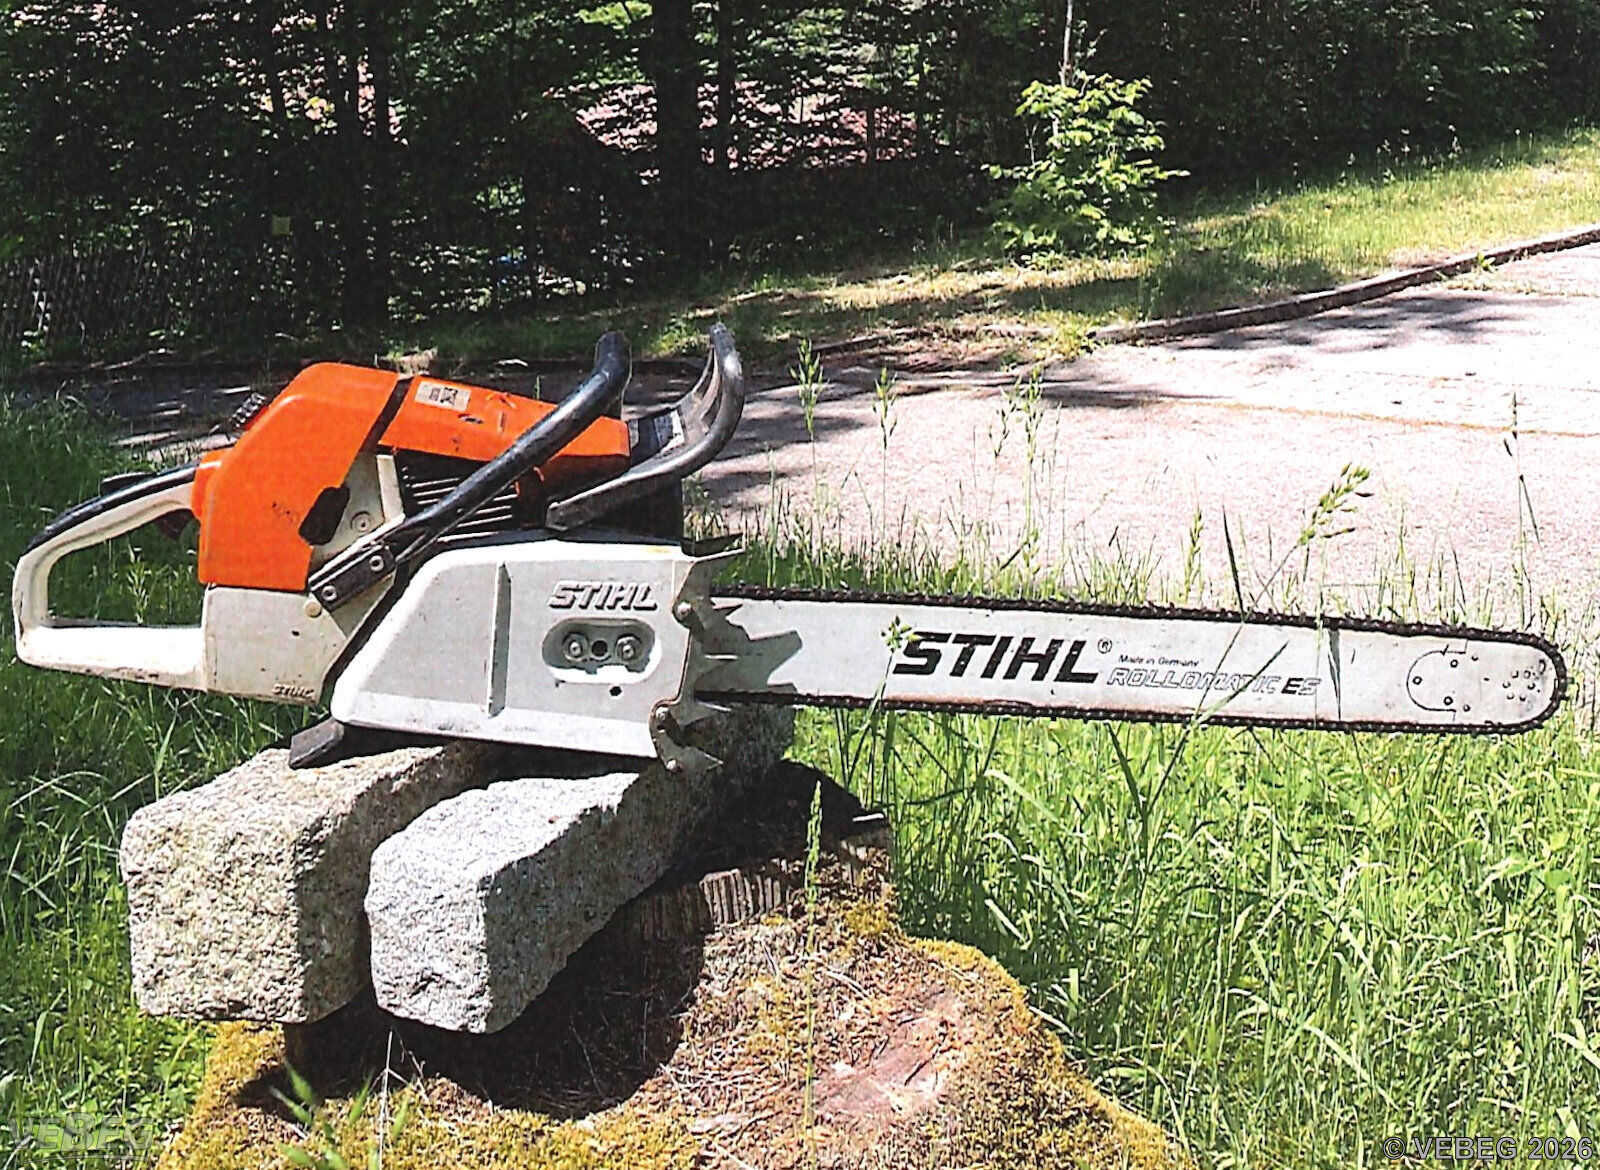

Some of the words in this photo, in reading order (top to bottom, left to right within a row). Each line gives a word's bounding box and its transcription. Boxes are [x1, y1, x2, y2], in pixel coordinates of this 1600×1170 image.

[549, 579, 658, 611] STIHL
[1119, 654, 1144, 665] Made
[1157, 656, 1200, 668] Germany
[1106, 667, 1281, 694] ROLLOMATIC
[1281, 677, 1321, 696] ES
